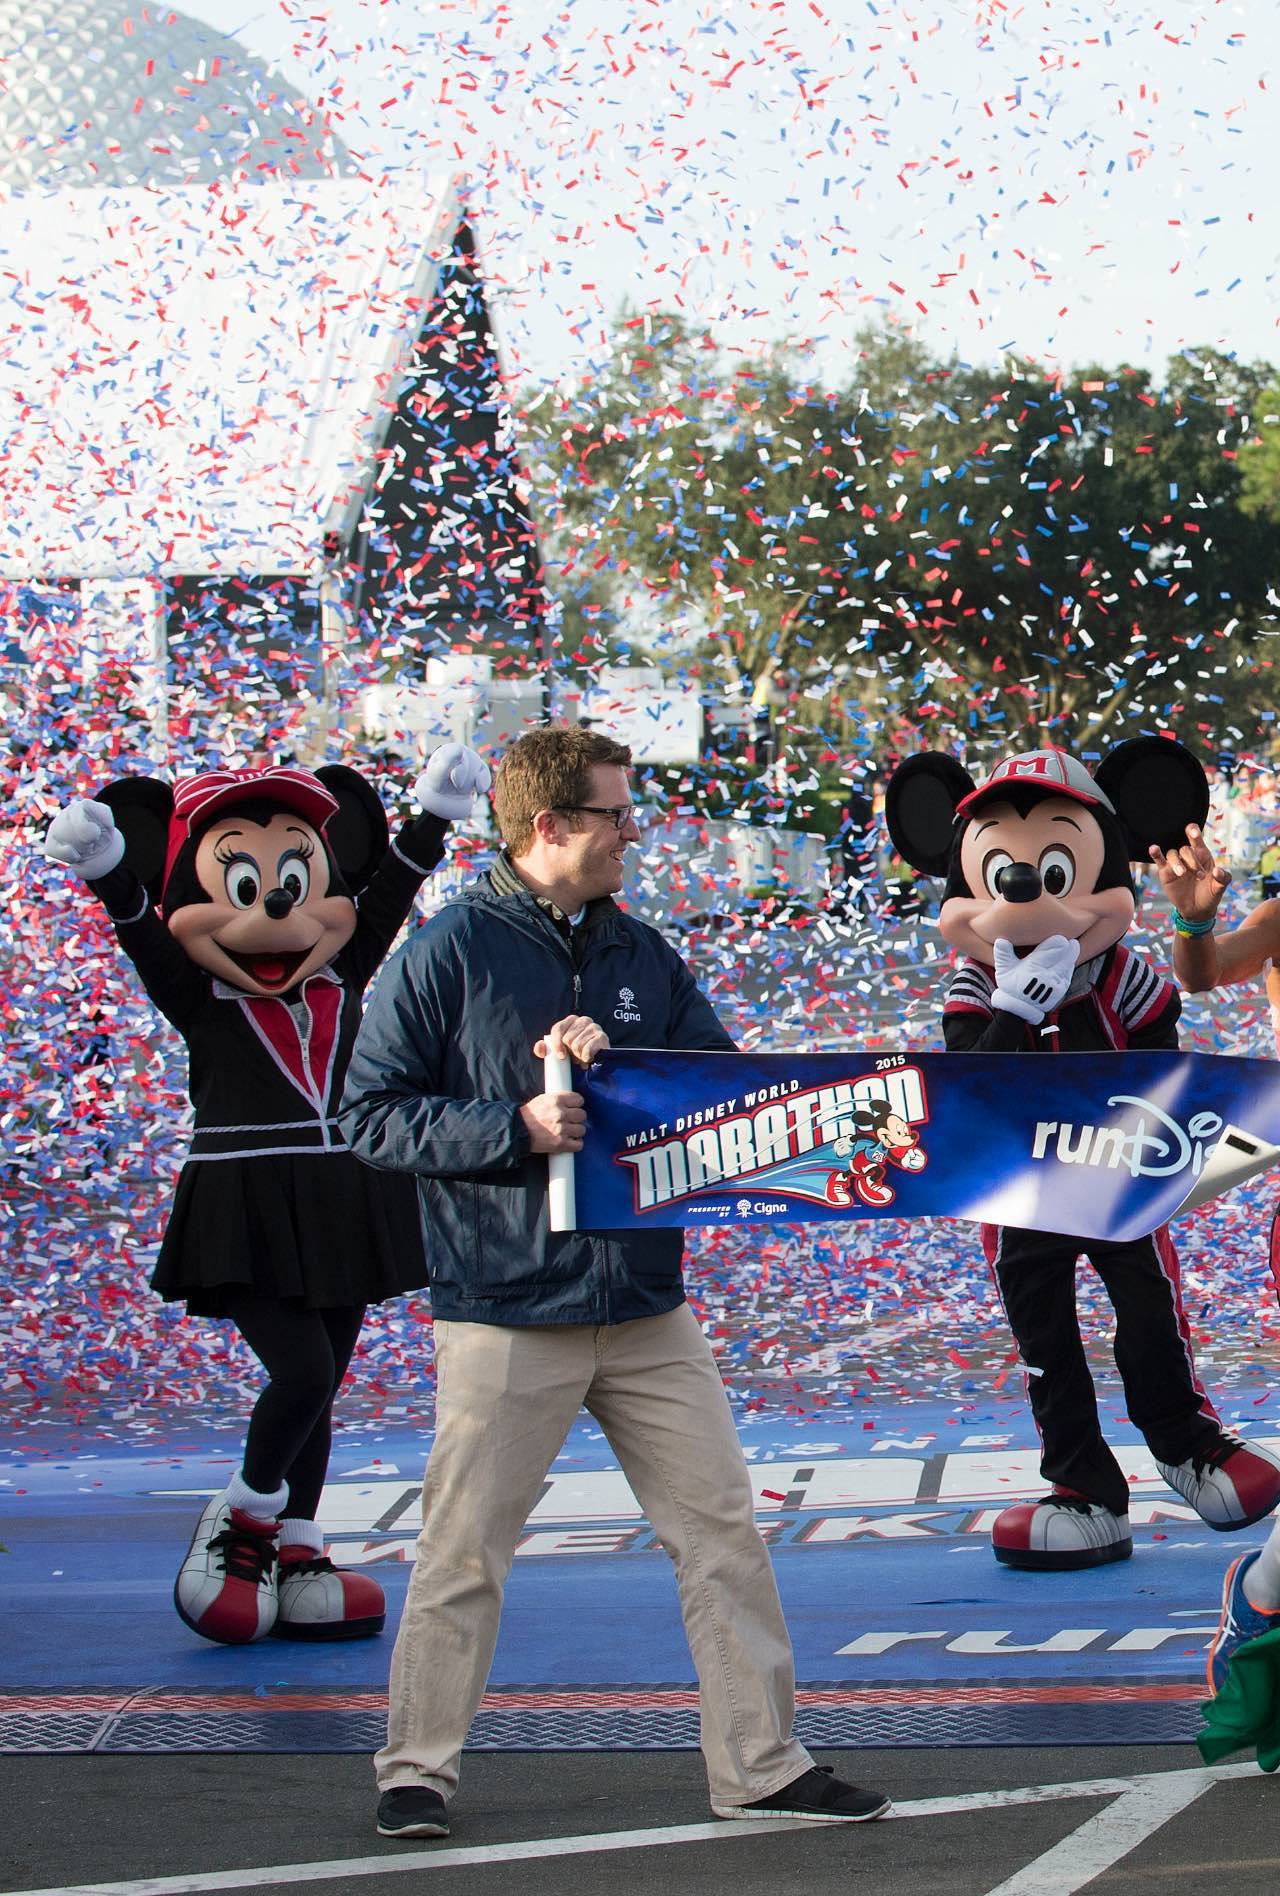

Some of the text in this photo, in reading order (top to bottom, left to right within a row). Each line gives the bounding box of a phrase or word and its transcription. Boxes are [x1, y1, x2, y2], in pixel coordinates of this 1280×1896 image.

[1003, 756, 1056, 777] M
[613, 1008, 641, 1023] Cigna
[875, 1055, 906, 1071] 2015
[625, 1079, 801, 1149] WALT DISNEY WORLD
[618, 1068, 925, 1208] MARATHON
[1031, 1096, 1224, 1177] runDi
[687, 1205, 731, 1213] PRESENTED
[753, 1202, 788, 1216] Cigna
